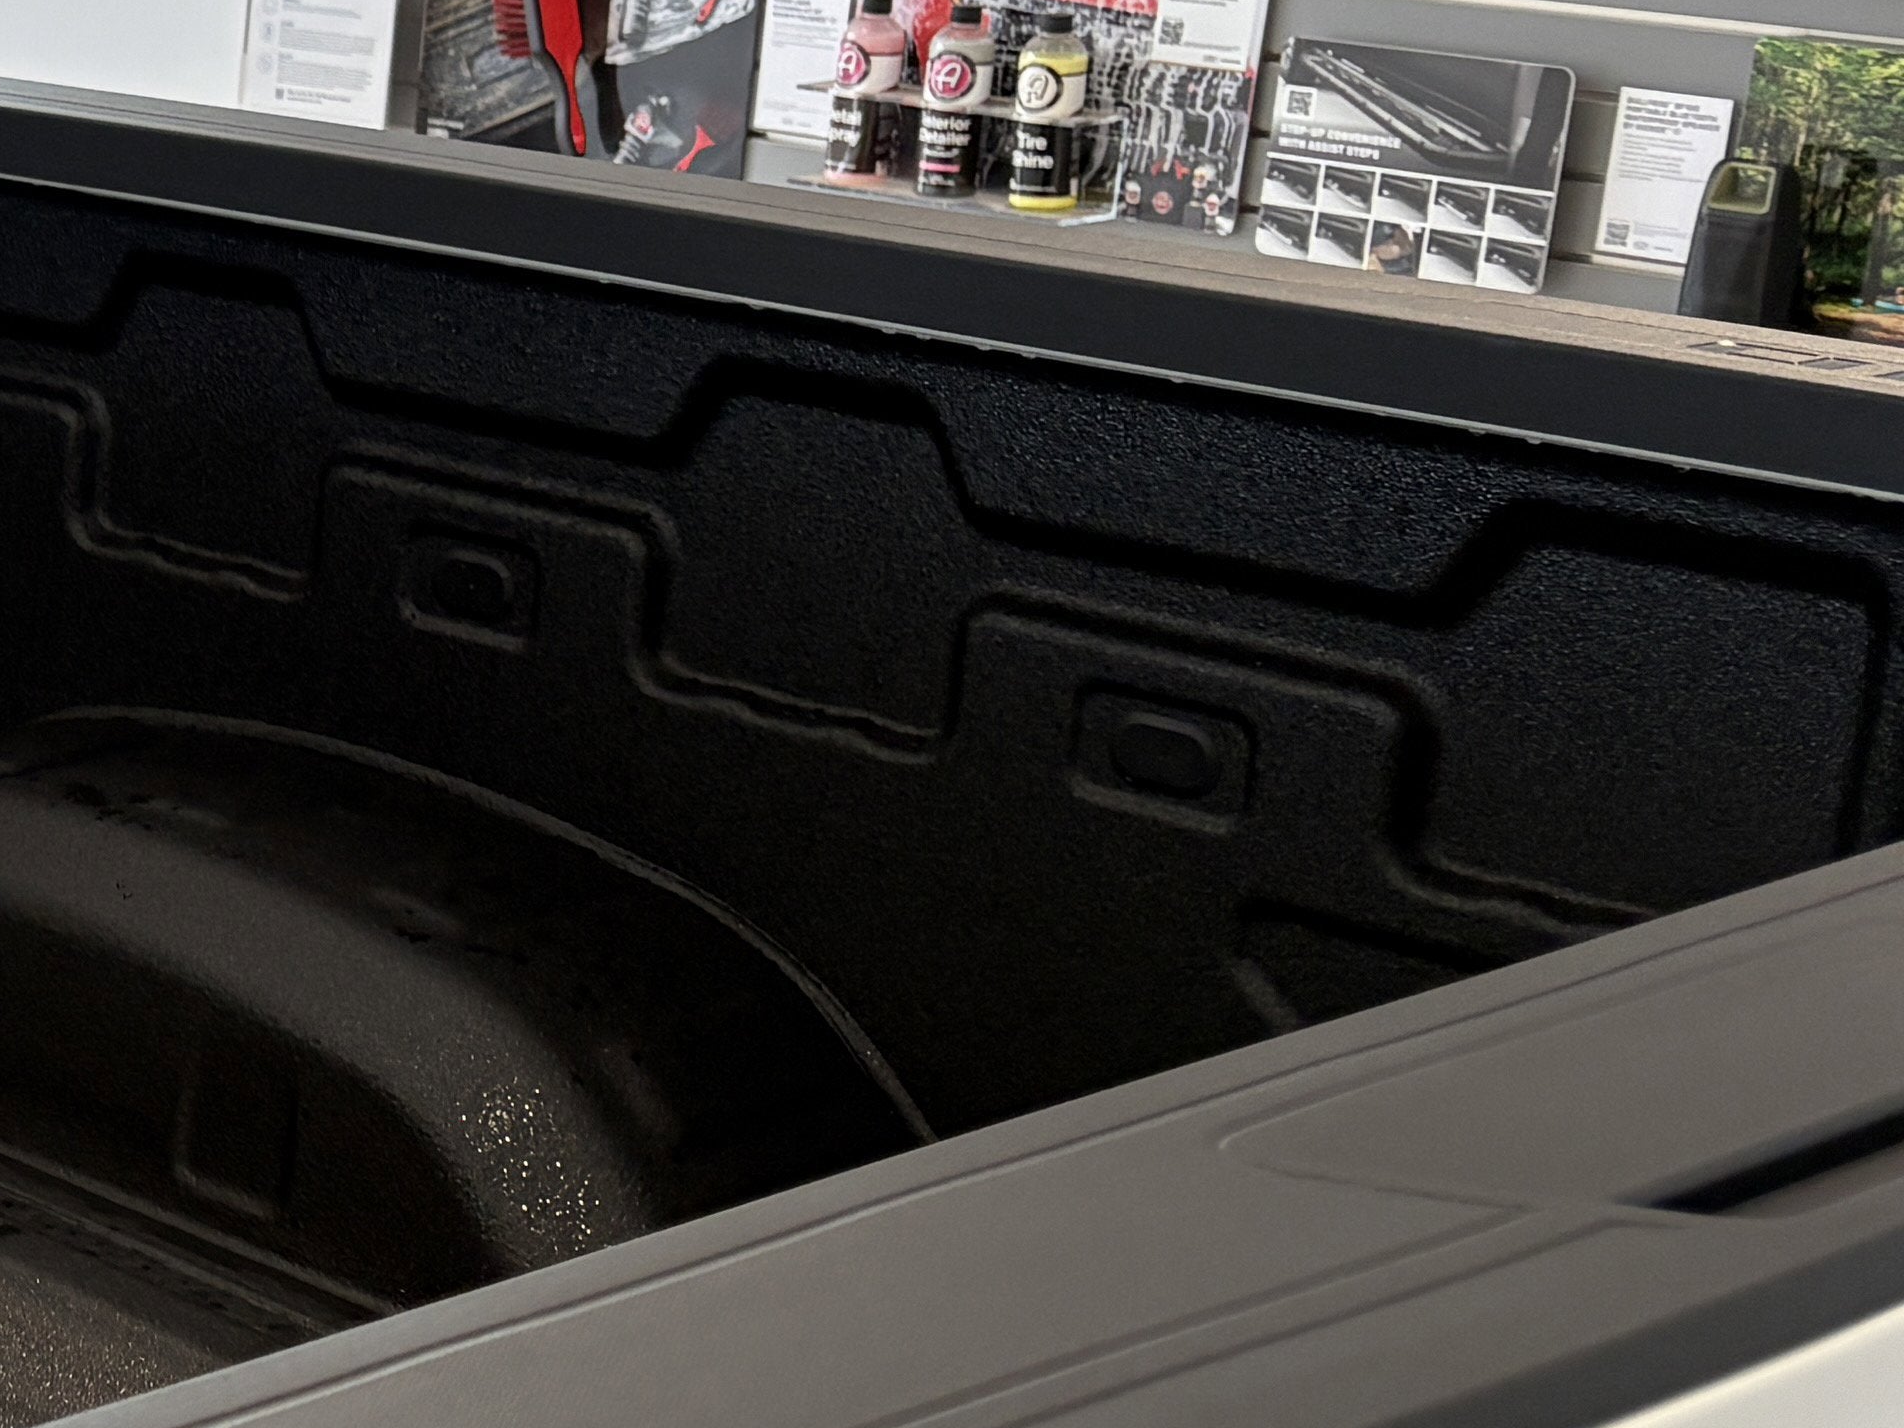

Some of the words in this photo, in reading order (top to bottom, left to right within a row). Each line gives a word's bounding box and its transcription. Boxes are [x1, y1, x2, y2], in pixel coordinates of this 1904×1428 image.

[921, 113, 971, 132] nterior
[1015, 129, 1048, 151] Tire
[1012, 150, 1054, 170] Shine
